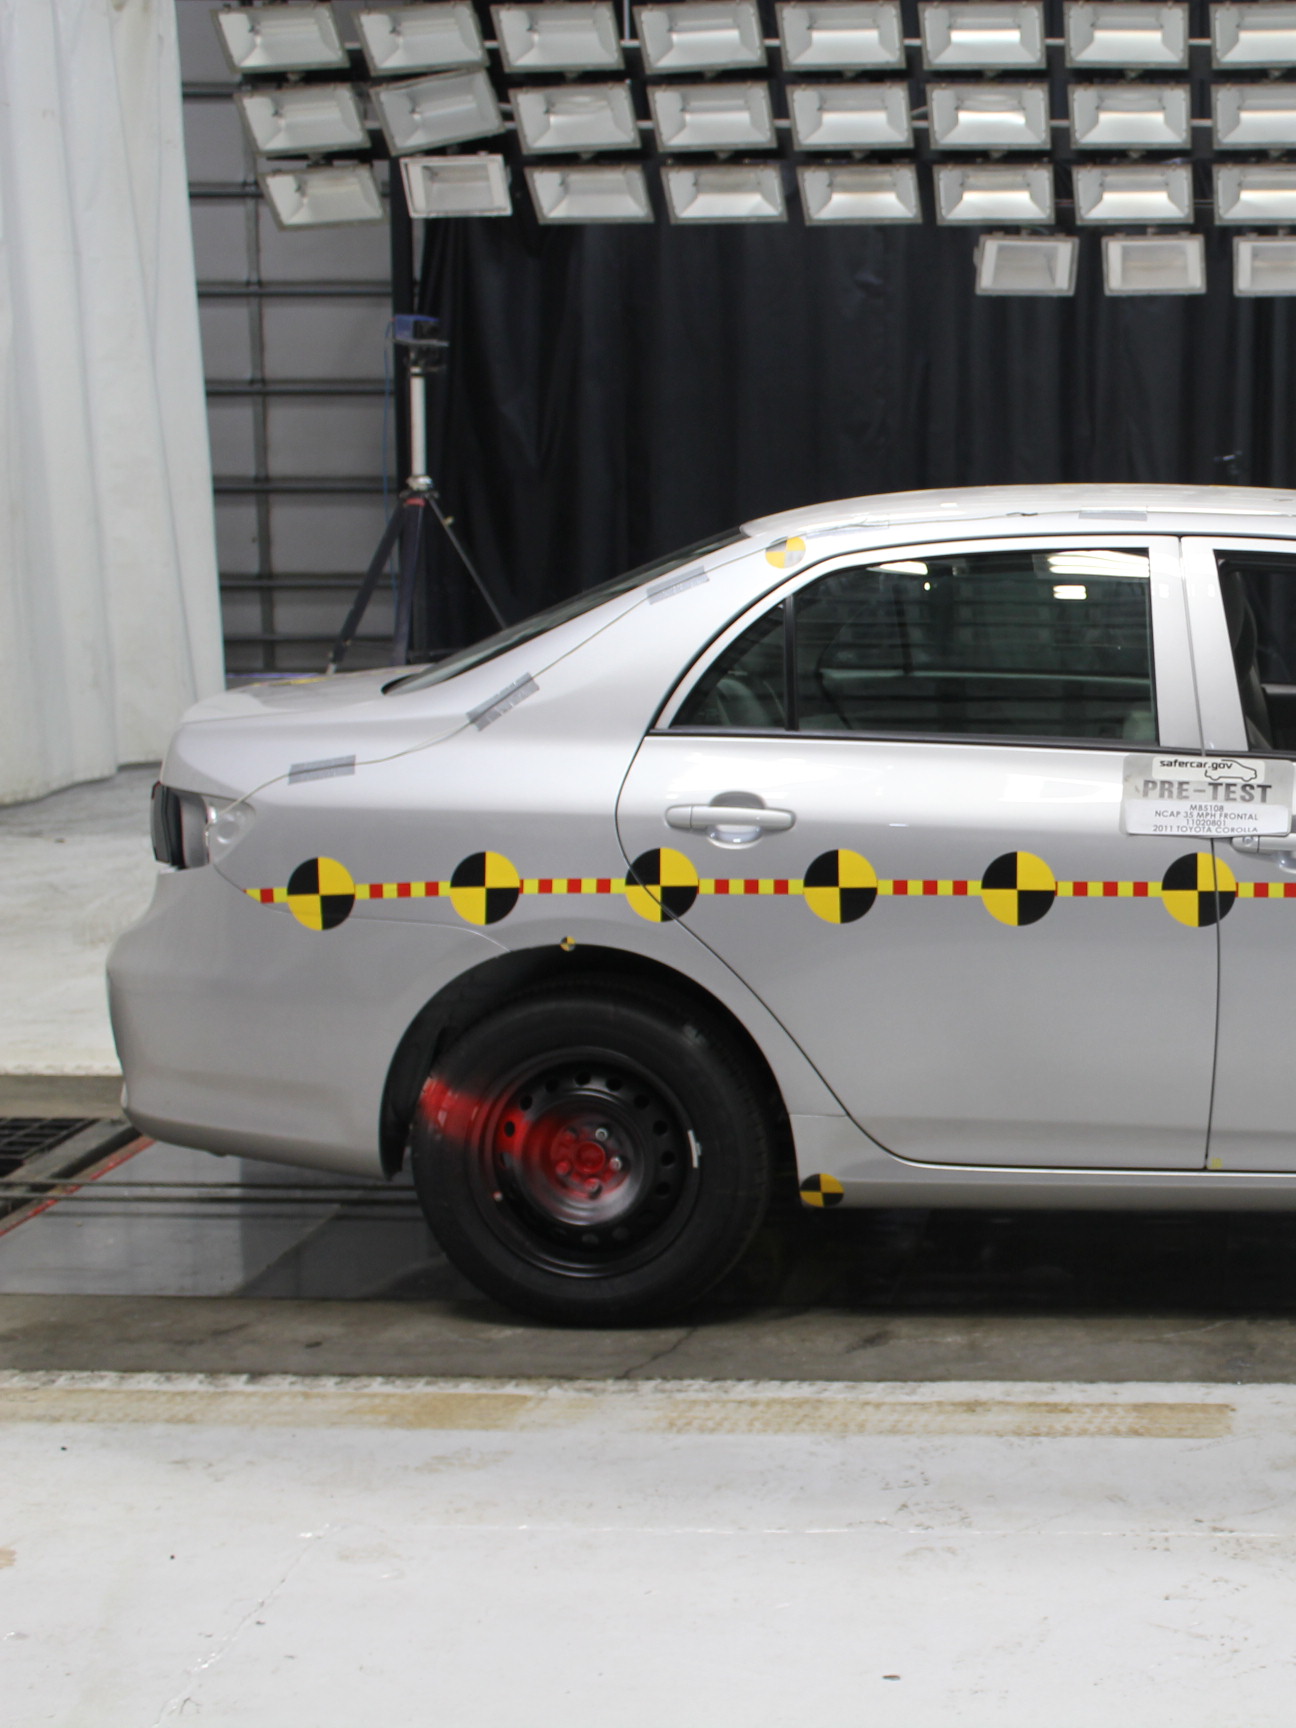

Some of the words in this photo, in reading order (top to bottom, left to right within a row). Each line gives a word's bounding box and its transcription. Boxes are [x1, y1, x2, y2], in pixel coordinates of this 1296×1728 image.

[1159, 758, 1233, 771] safercar.gov
[1142, 780, 1272, 803] PRE-TEST
[1189, 804, 1224, 812] MB5108
[1155, 810, 1180, 819] NCAP
[1218, 812, 1258, 821] FRONTAL
[1186, 819, 1226, 827] 11020801
[1215, 826, 1258, 834] COROLLA
